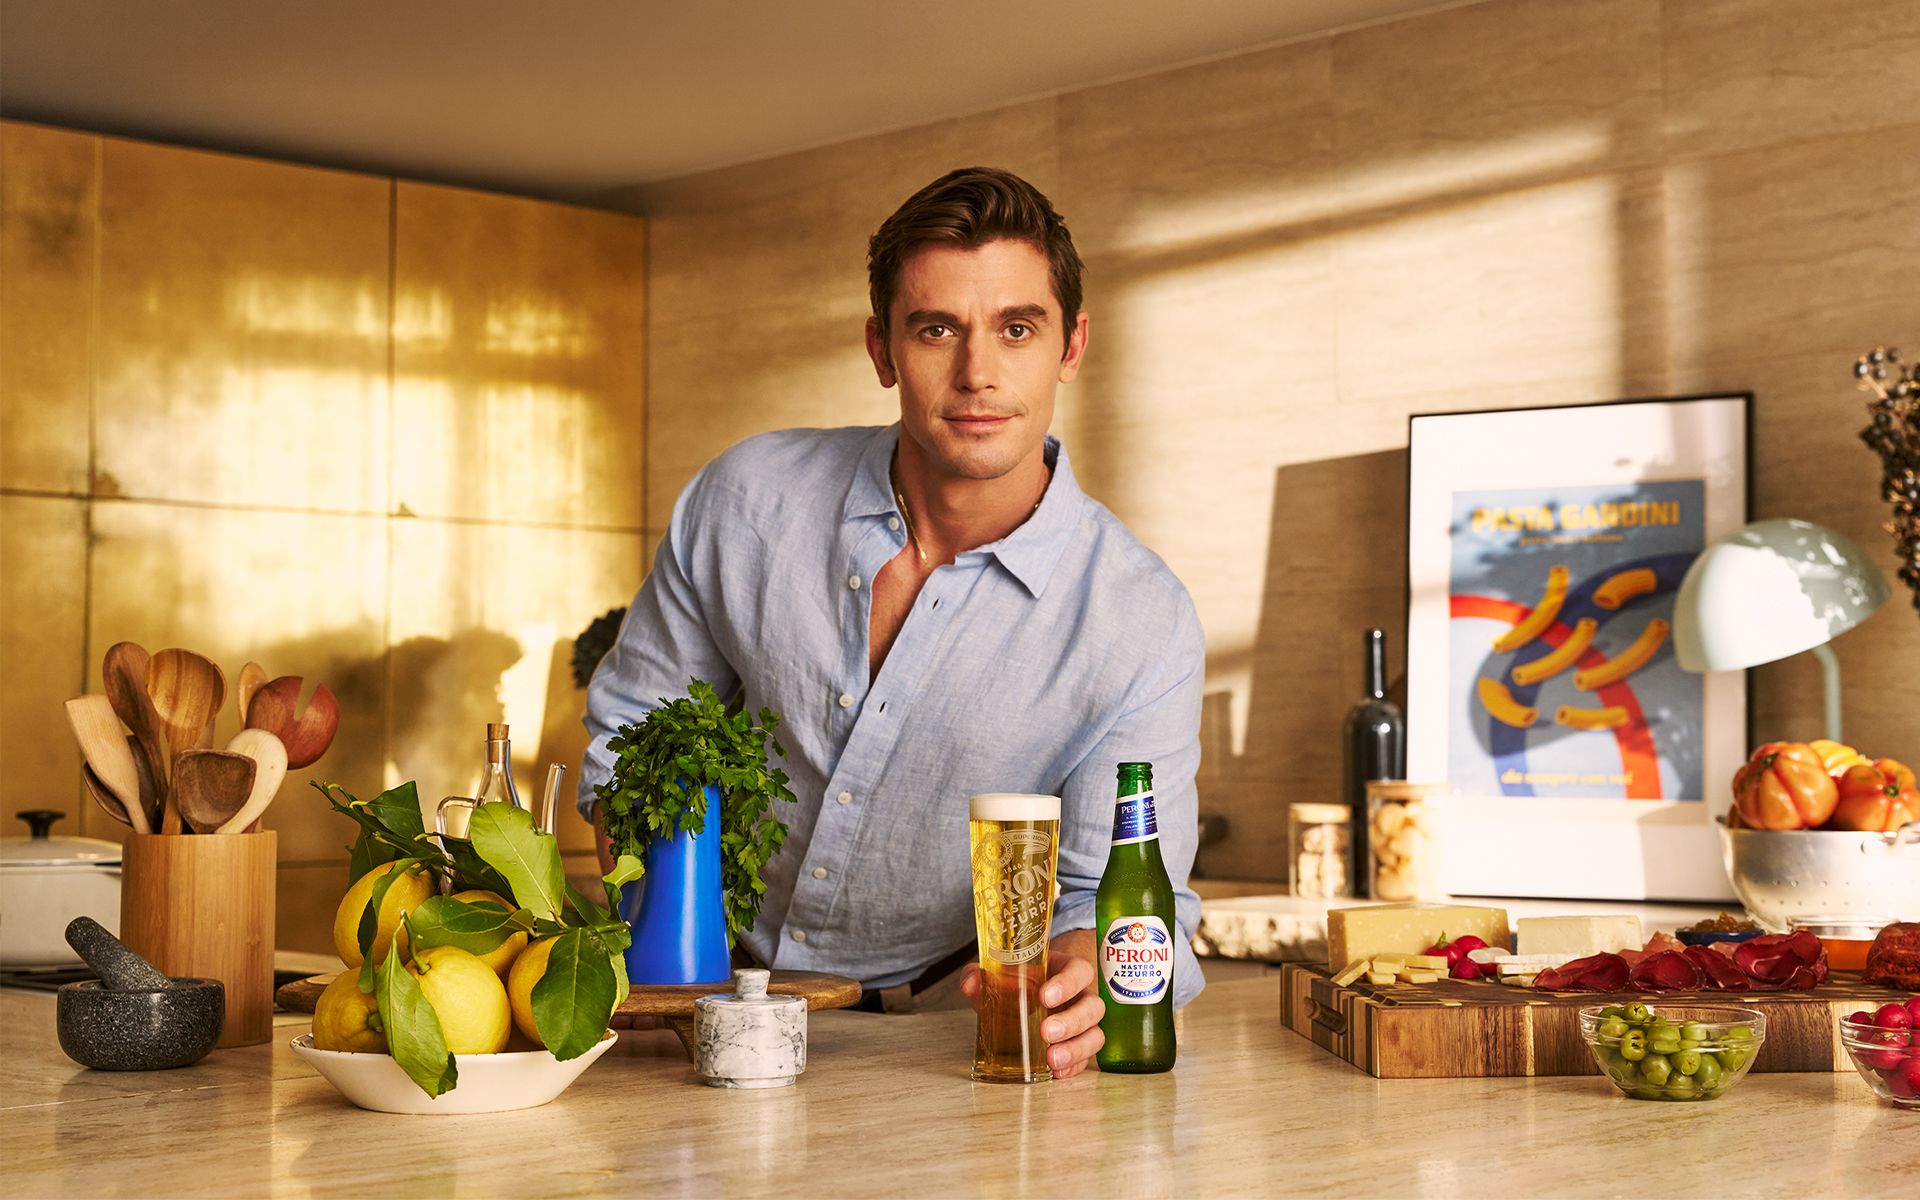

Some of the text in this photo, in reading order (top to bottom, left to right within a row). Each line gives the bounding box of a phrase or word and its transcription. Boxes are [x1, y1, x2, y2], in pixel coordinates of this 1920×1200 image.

[1003, 891, 1043, 919] ASTRO
[1011, 940, 1045, 961] ITALIAN
[1106, 946, 1168, 963] PERONI
[1113, 970, 1162, 978] AZZURRO
[1122, 989, 1154, 998] ITALIANA
